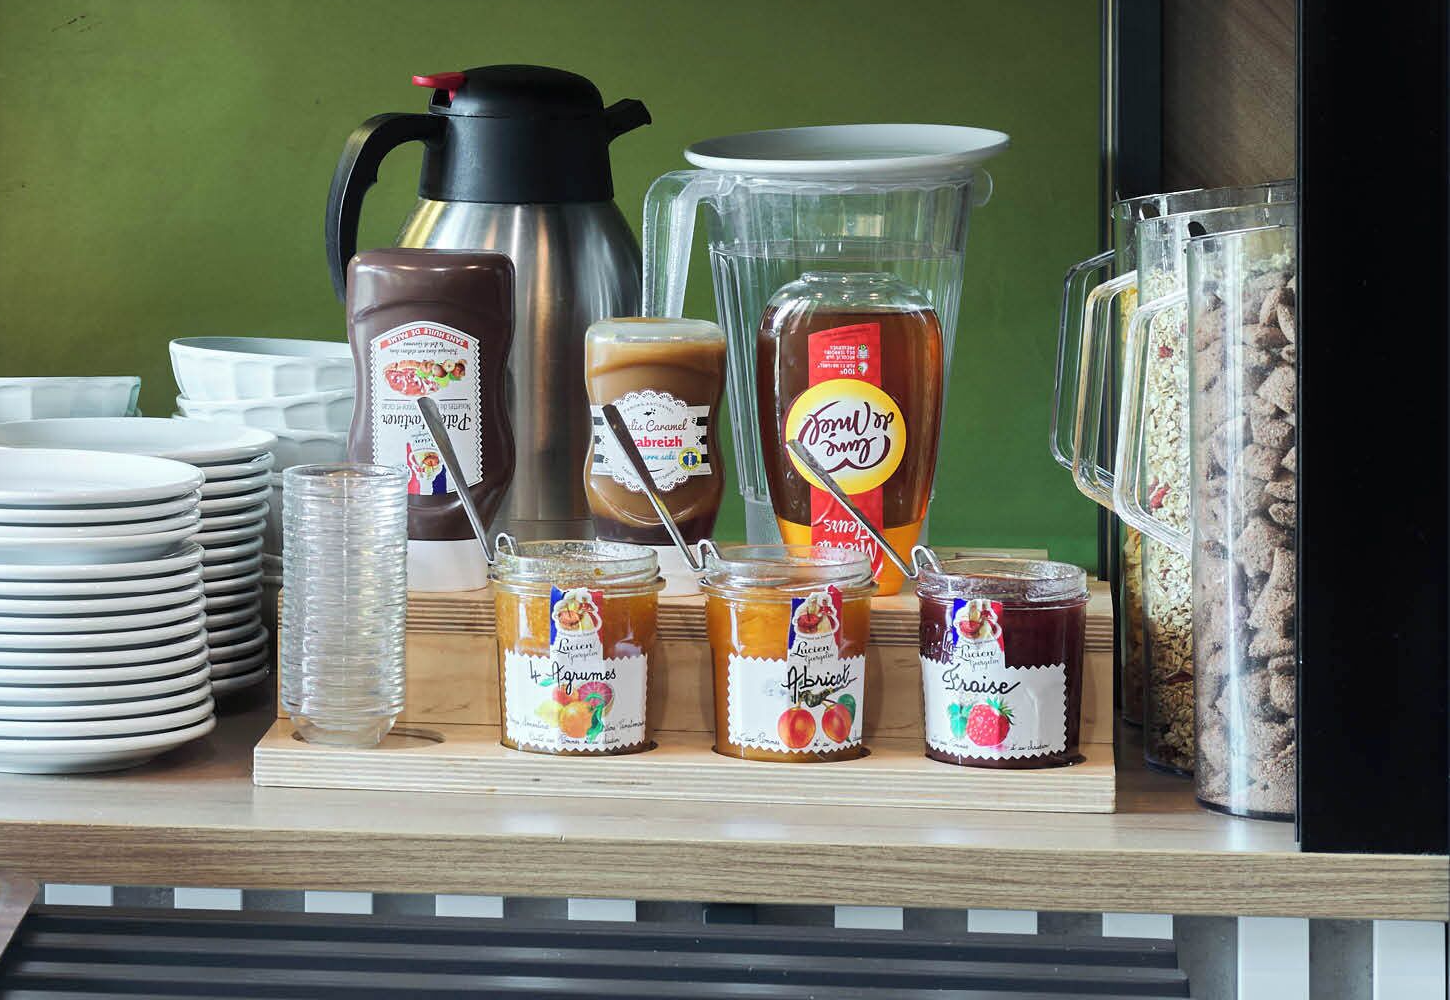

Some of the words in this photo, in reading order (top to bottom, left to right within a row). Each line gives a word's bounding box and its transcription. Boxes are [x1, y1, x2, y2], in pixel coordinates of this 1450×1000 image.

[424, 328, 445, 339] HUILE
[445, 333, 464, 346] SANS
[646, 418, 688, 432] Caramel
[873, 411, 894, 431] de
[553, 638, 594, 655] Lucien
[790, 641, 832, 658] Lucien
[953, 645, 996, 662] Lucien
[529, 660, 541, 684] 4
[547, 661, 617, 695] Agrumes
[781, 664, 858, 704] Abricot
[942, 663, 1021, 695] Fraise
